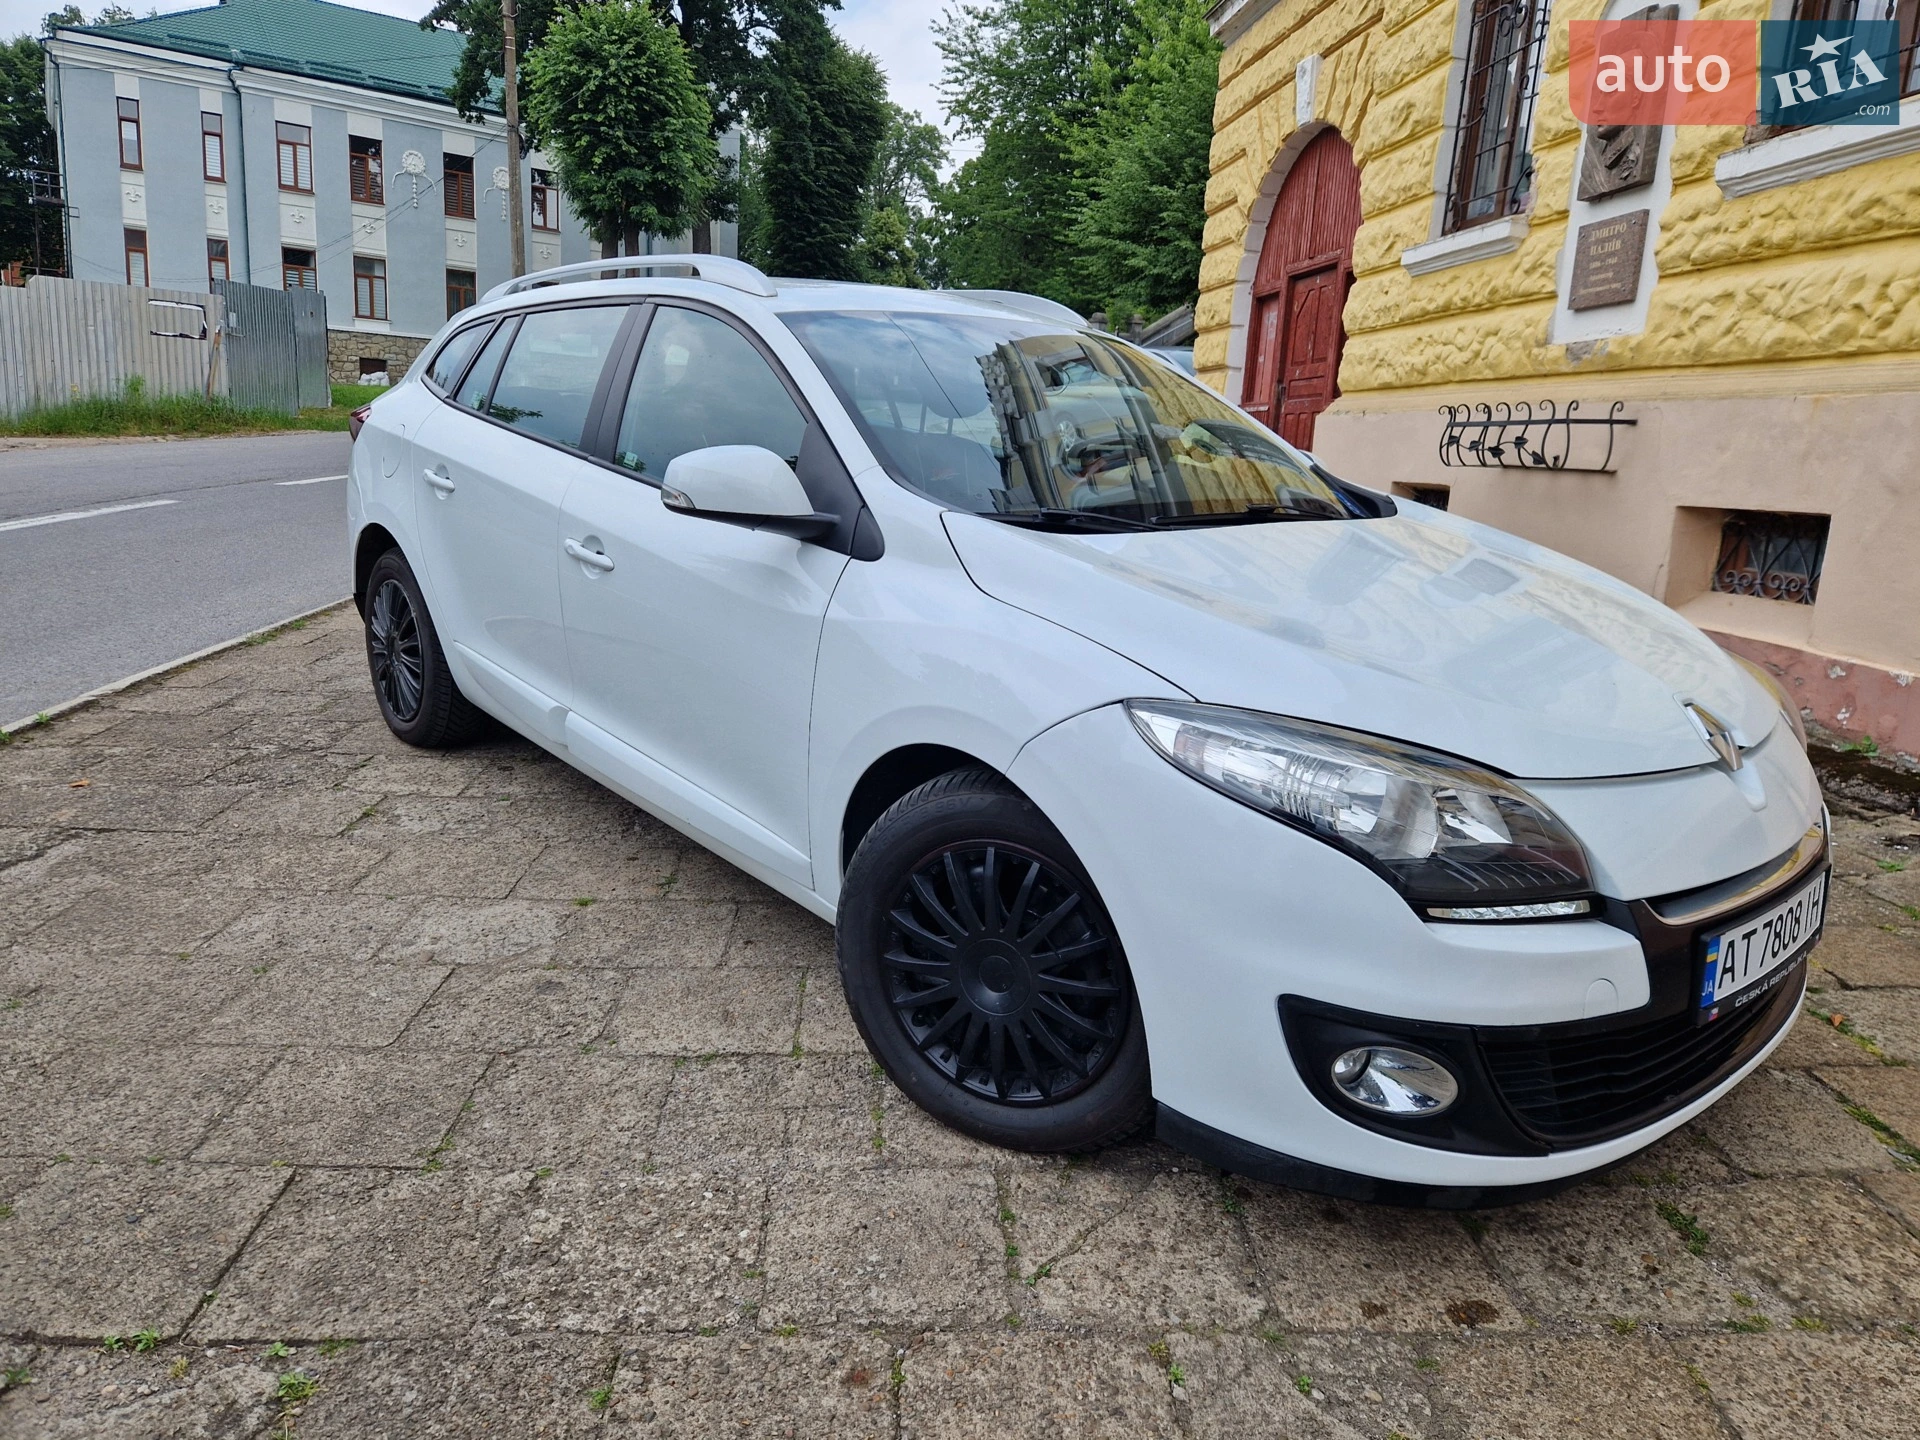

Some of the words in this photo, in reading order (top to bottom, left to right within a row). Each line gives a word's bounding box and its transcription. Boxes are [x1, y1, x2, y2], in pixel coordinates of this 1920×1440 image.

[1589, 222, 1627, 242] ДМИТРО
[1718, 928, 1759, 989] AT
[1759, 900, 1802, 968] 7808
[1804, 878, 1822, 934] IH
